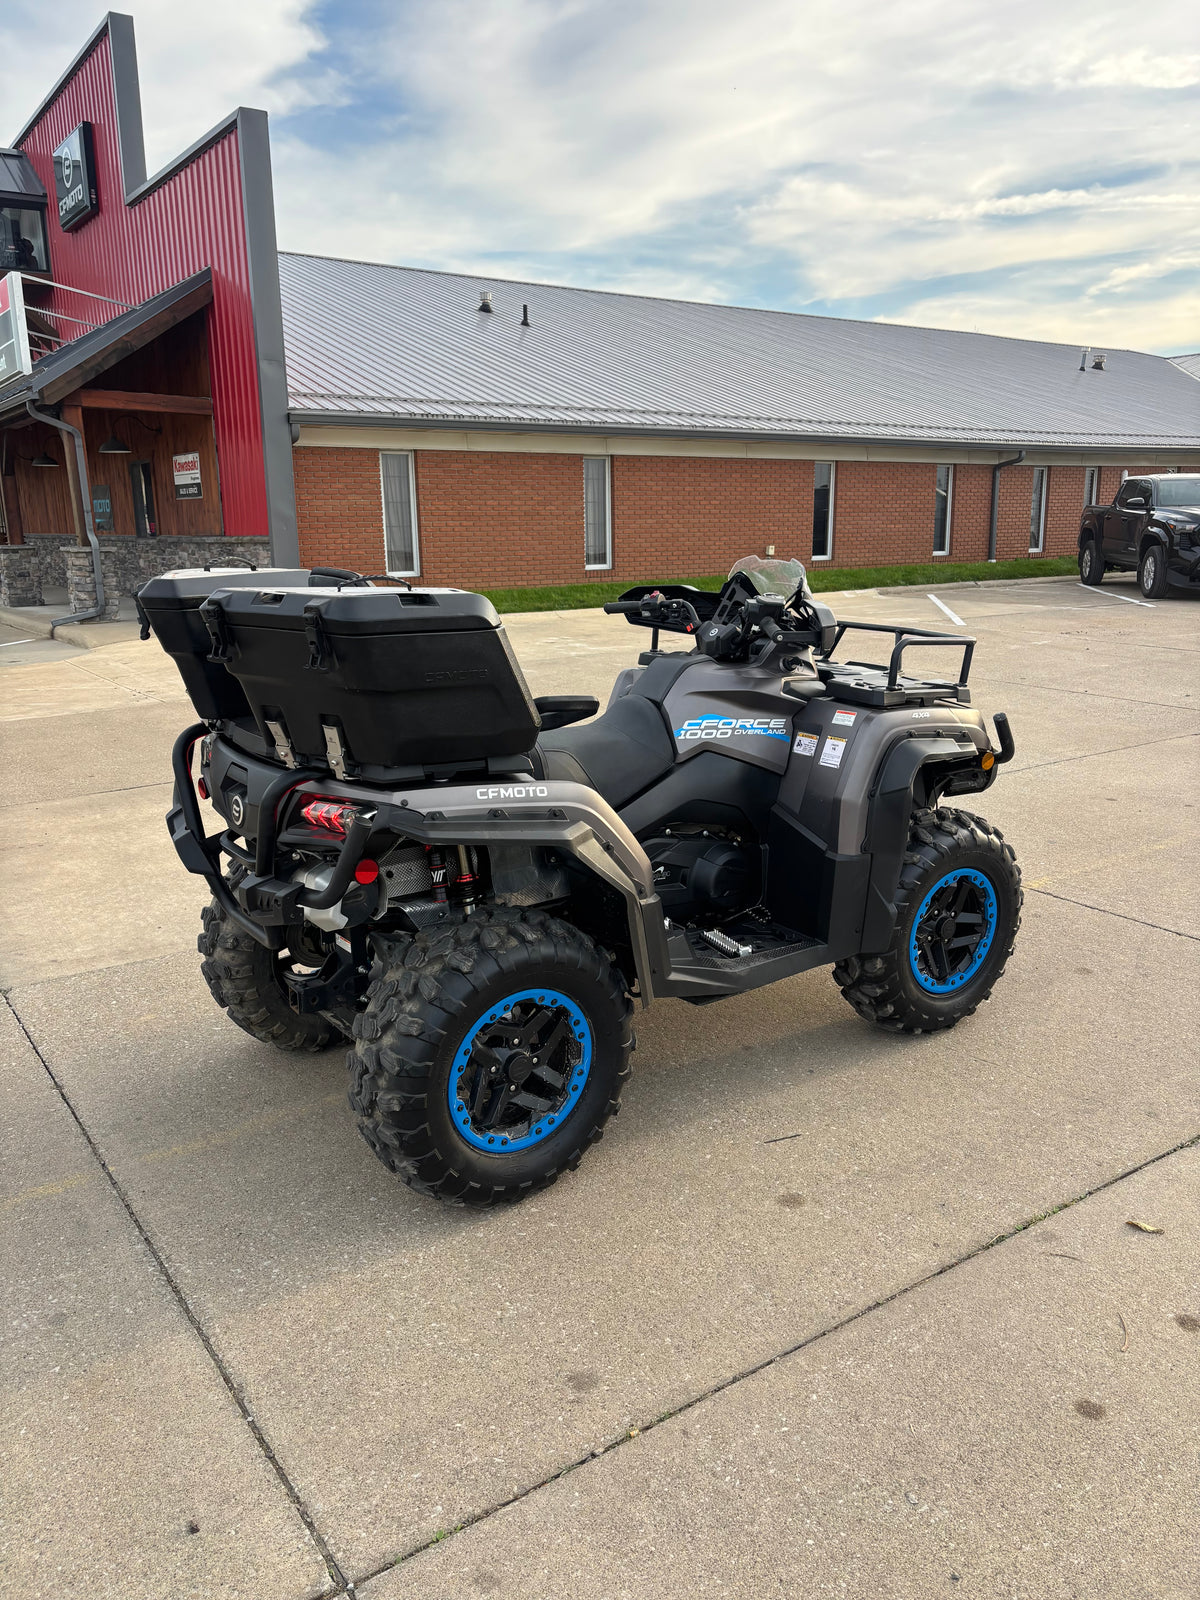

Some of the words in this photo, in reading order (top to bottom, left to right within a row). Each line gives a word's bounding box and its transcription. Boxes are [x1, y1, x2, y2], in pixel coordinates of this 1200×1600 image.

[59, 184, 83, 216] CFMOTO
[174, 456, 199, 472] Kawasaki
[682, 718, 786, 729] CFORCE
[678, 729, 732, 740] 1000
[476, 786, 548, 799] CFMOTO
